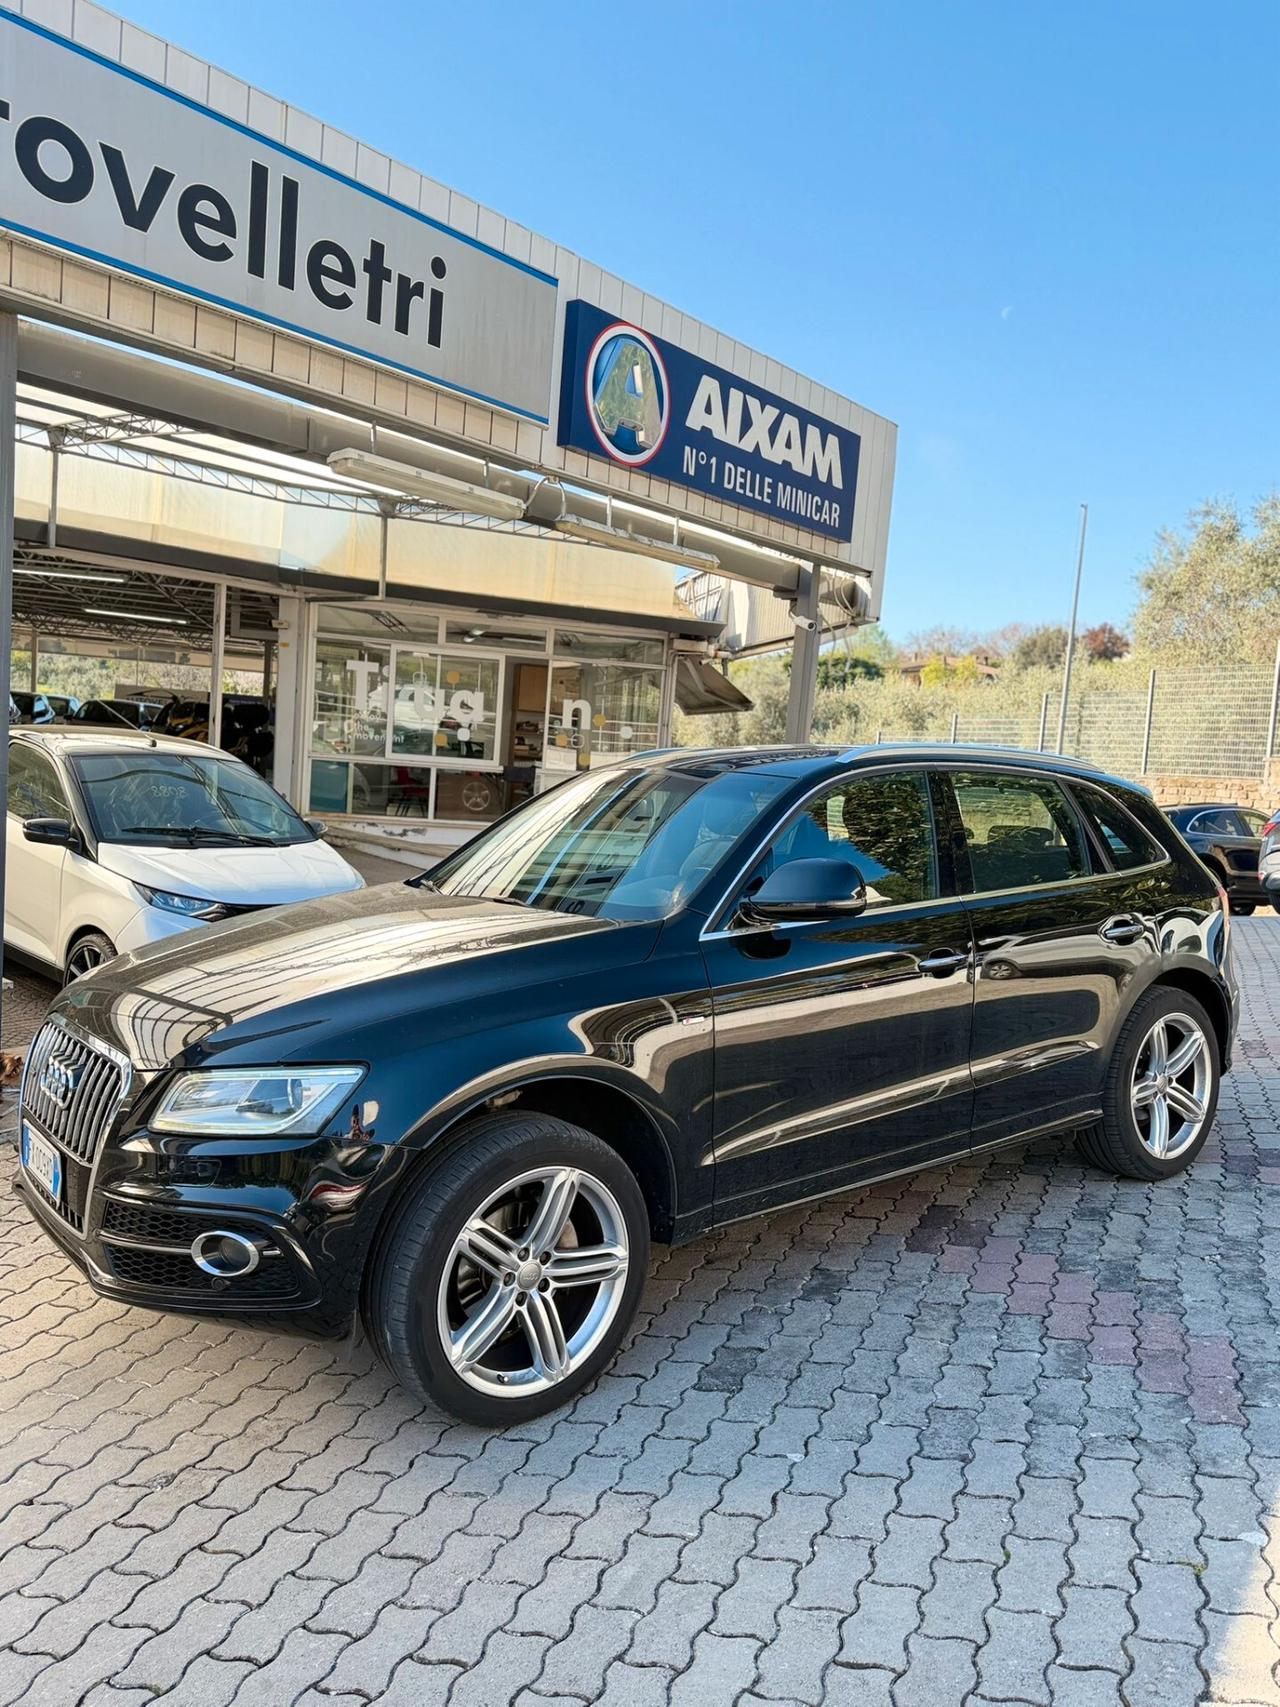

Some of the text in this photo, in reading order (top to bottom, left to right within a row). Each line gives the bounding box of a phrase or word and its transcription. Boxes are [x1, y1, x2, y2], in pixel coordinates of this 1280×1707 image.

[0, 98, 446, 348] ovelletri
[685, 374, 843, 490] AIXAM
[724, 462, 772, 505] DELLE
[776, 482, 841, 529] MINICAR
